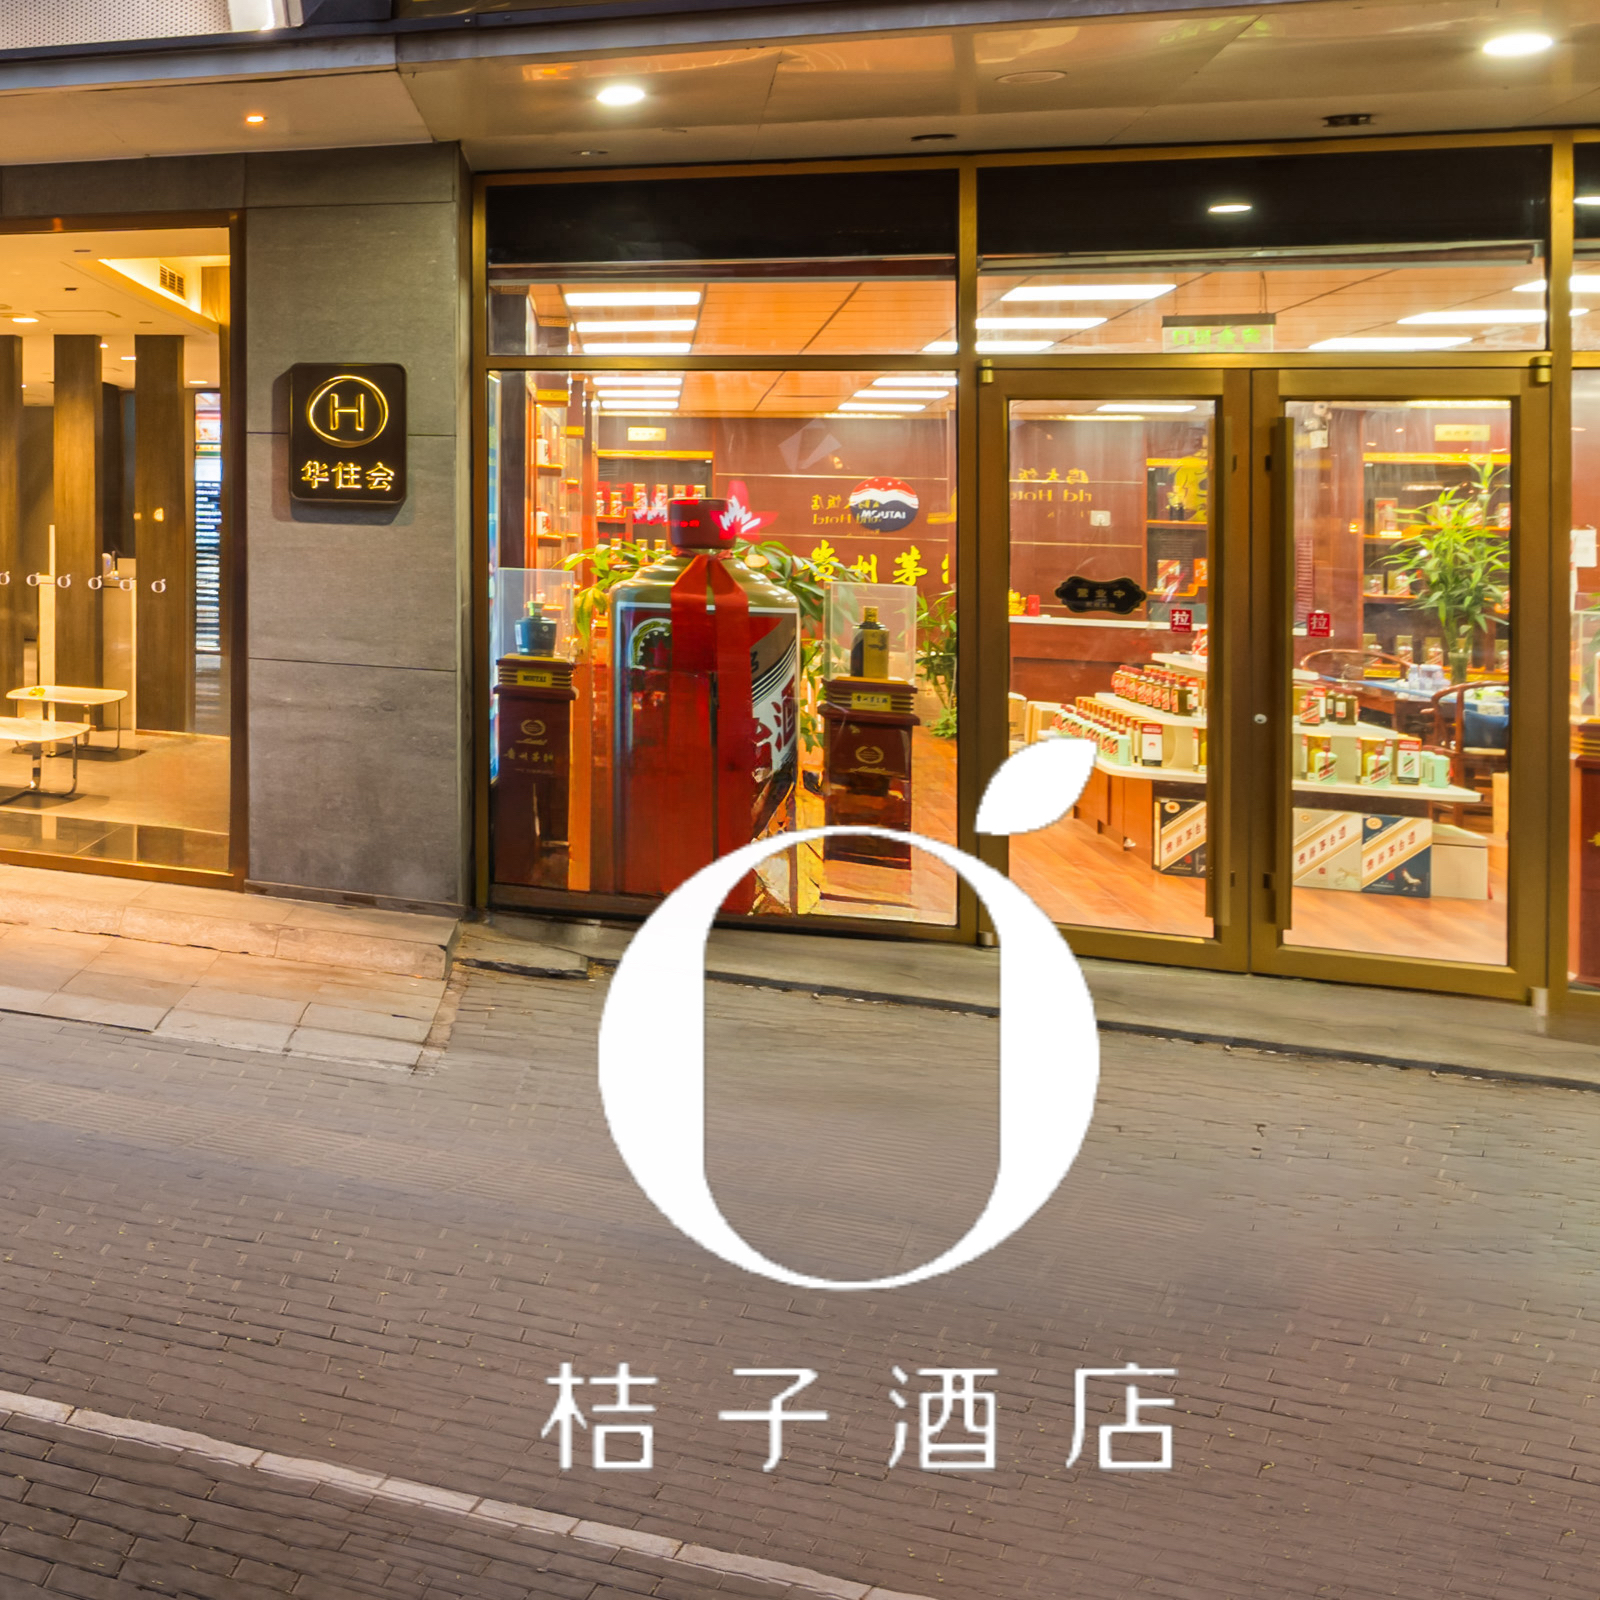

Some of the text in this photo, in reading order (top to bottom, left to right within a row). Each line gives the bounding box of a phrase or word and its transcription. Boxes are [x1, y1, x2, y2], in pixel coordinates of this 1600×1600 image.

[301, 460, 395, 492] 华住会
[860, 509, 907, 520] MOUTAI
[802, 539, 949, 586] 贵州茅
[1172, 610, 1191, 626] 拉
[1310, 614, 1329, 630] 拉
